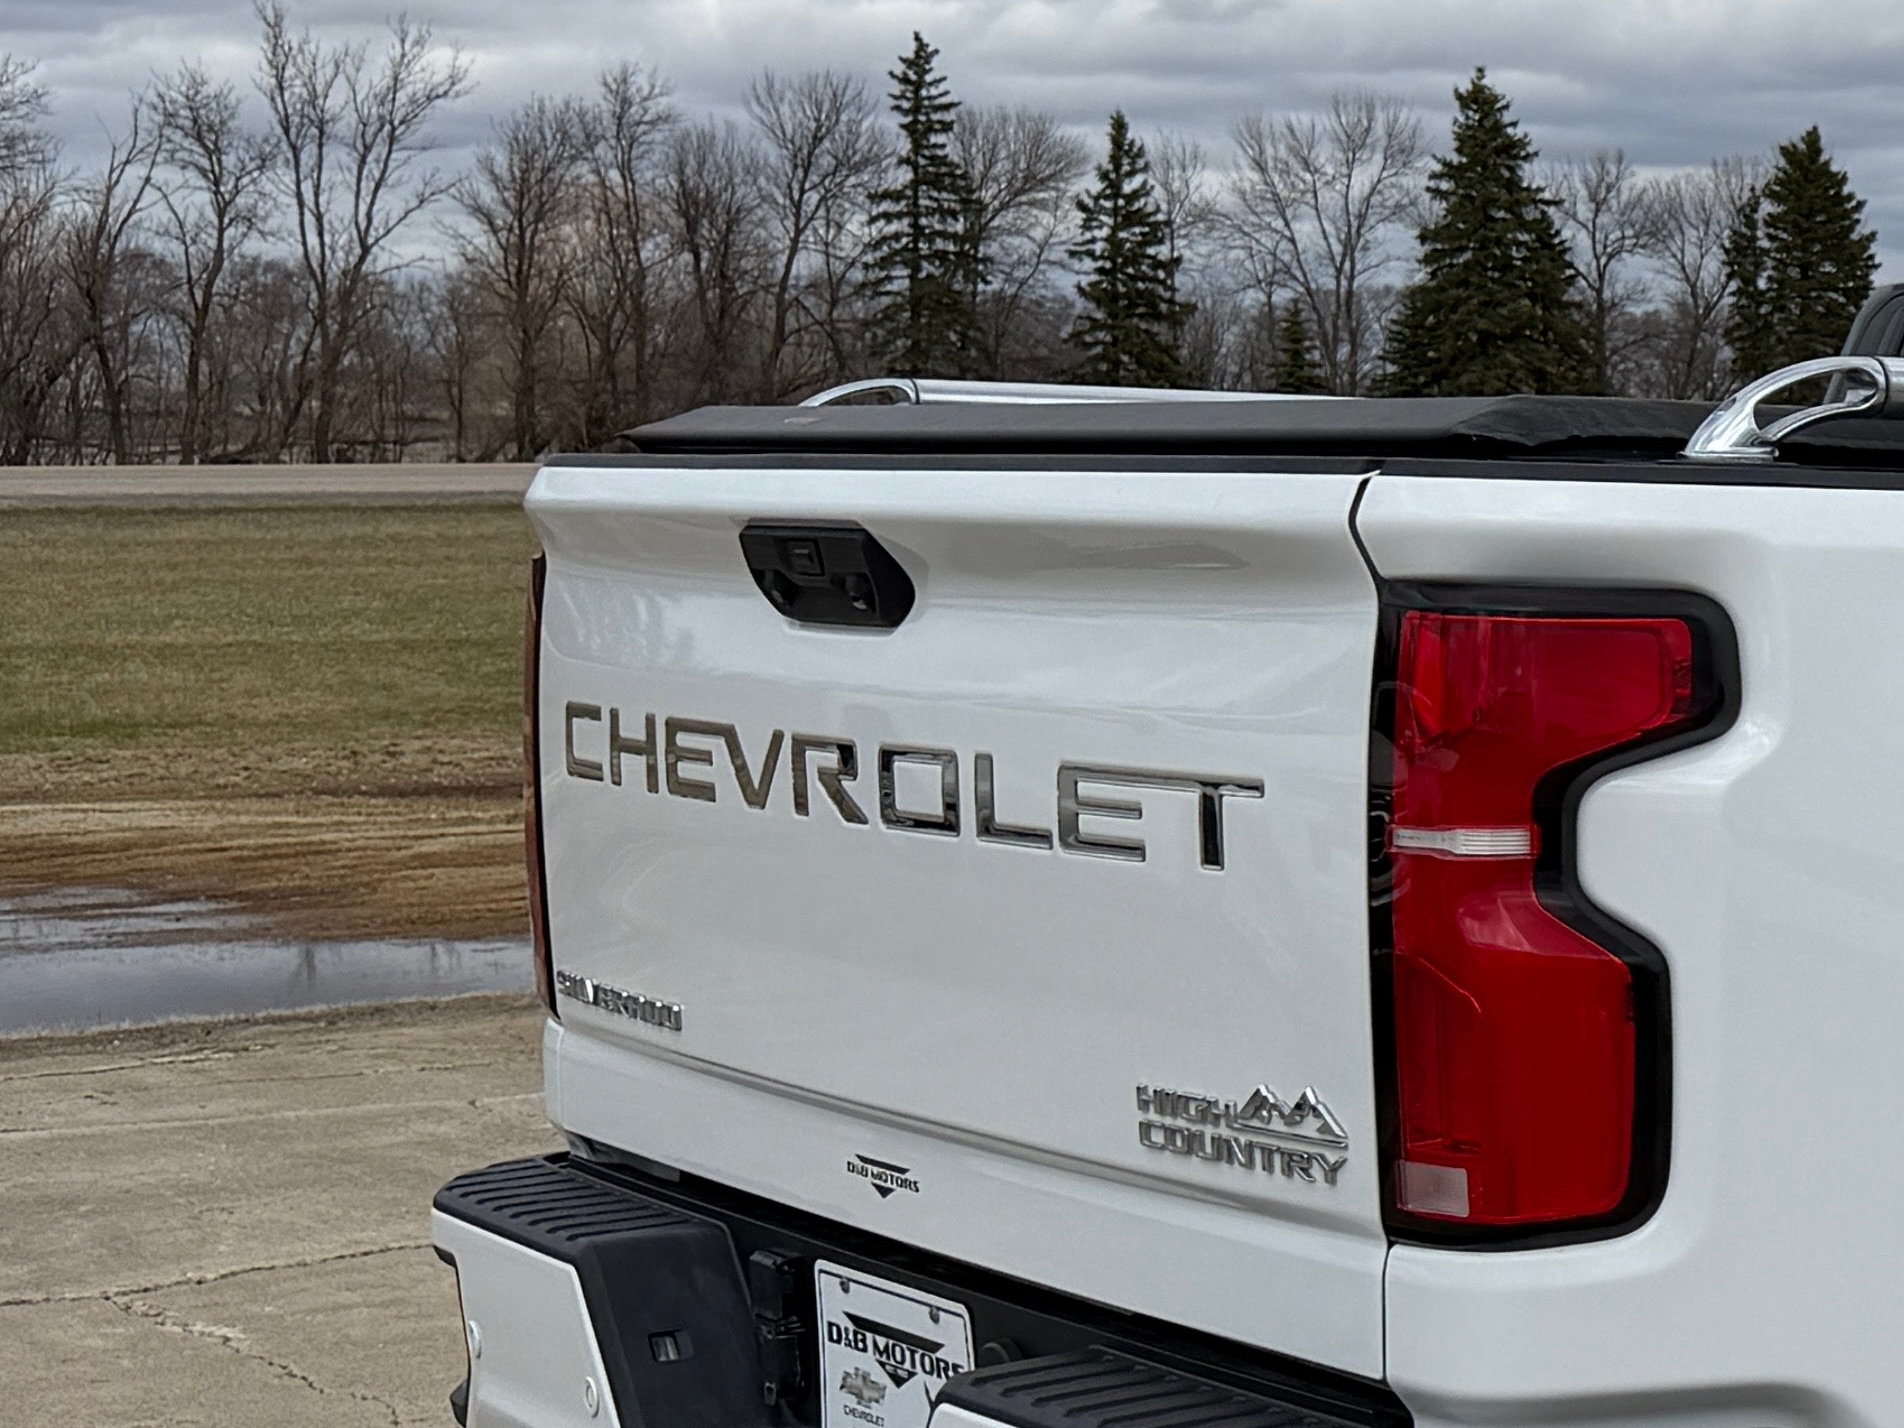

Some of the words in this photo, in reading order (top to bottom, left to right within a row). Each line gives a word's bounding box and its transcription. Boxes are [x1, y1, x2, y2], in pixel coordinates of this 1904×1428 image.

[565, 701, 1265, 871] CHEVROLET
[1136, 1083, 1238, 1127] HIGH
[1138, 1118, 1349, 1186] COUNTRY
[870, 1167, 920, 1194] MOTORS
[827, 1321, 868, 1353] D&B
